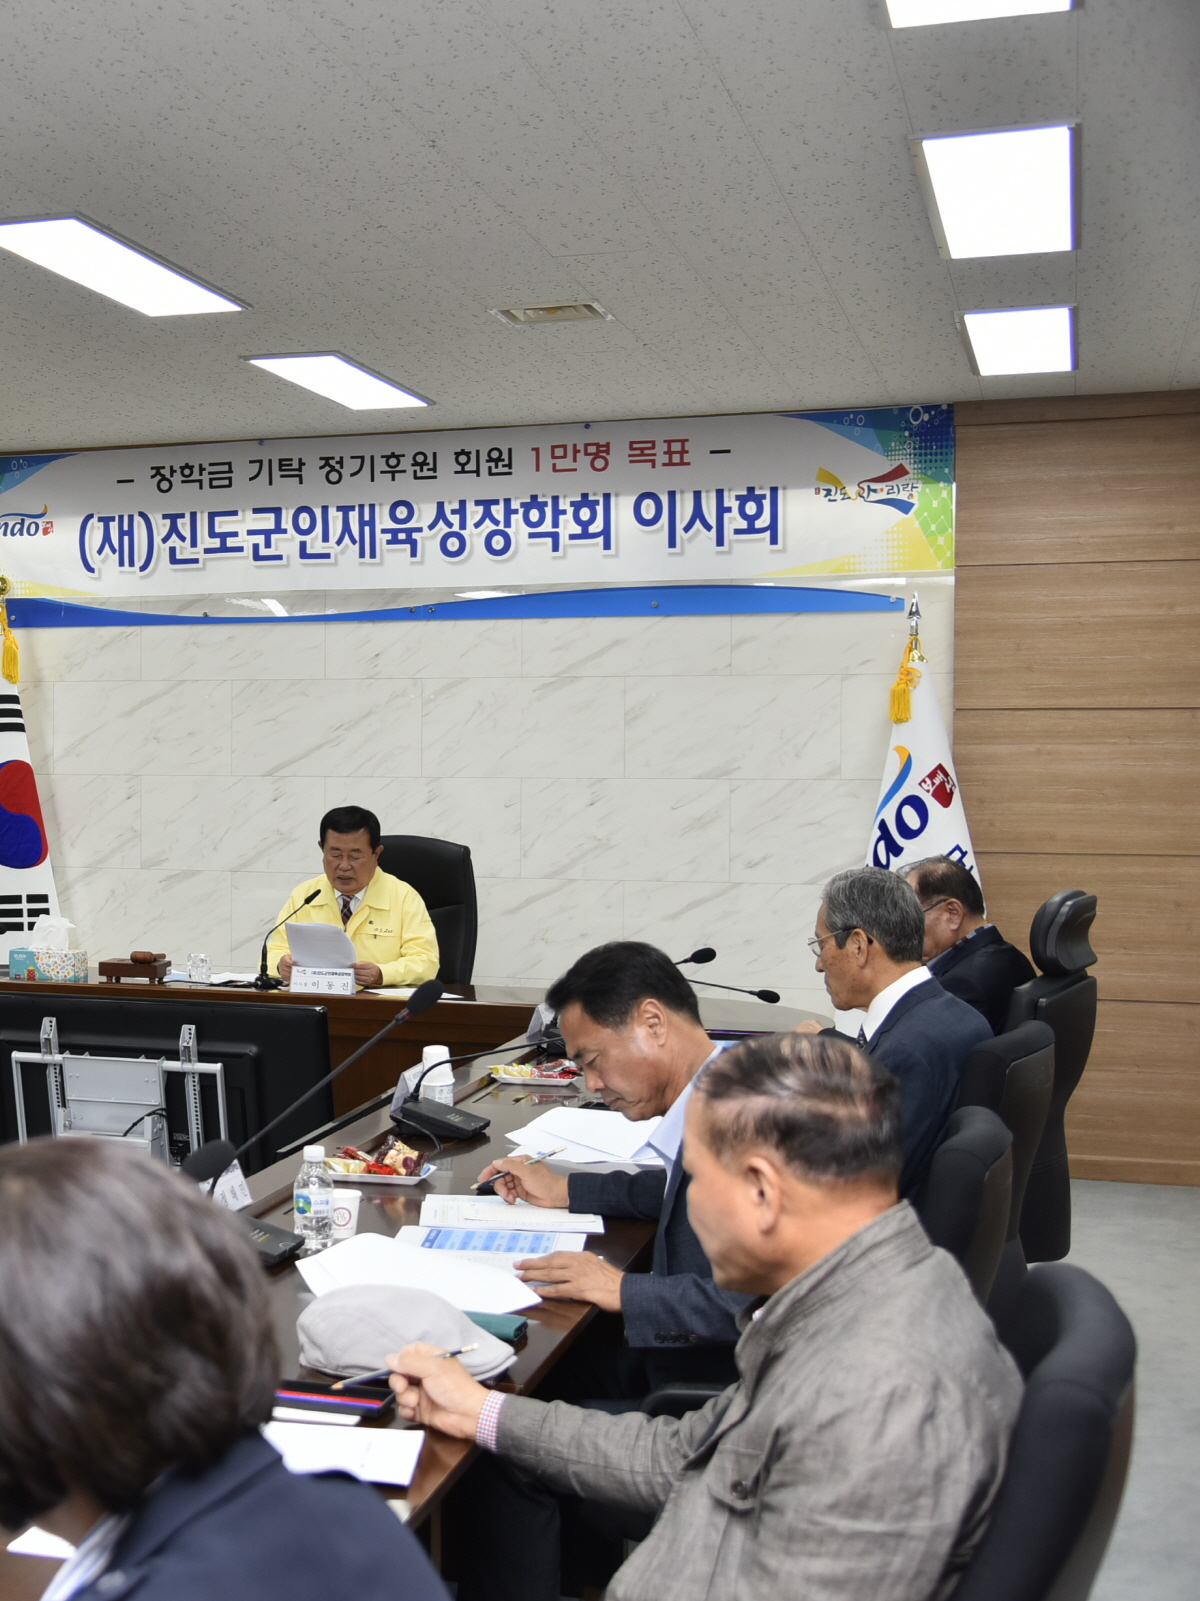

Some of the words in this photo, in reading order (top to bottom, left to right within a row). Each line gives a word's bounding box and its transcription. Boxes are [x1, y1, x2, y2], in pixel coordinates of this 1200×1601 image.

[150, 461, 234, 494] 장학금
[248, 456, 307, 487] 기탁
[318, 450, 439, 487] 정기후원
[453, 445, 515, 478] 회원
[530, 440, 611, 473] 1만명
[627, 437, 692, 470] 목표
[78, 491, 613, 574] (재)진도군인재육성장학회
[633, 485, 781, 550] 이사회
